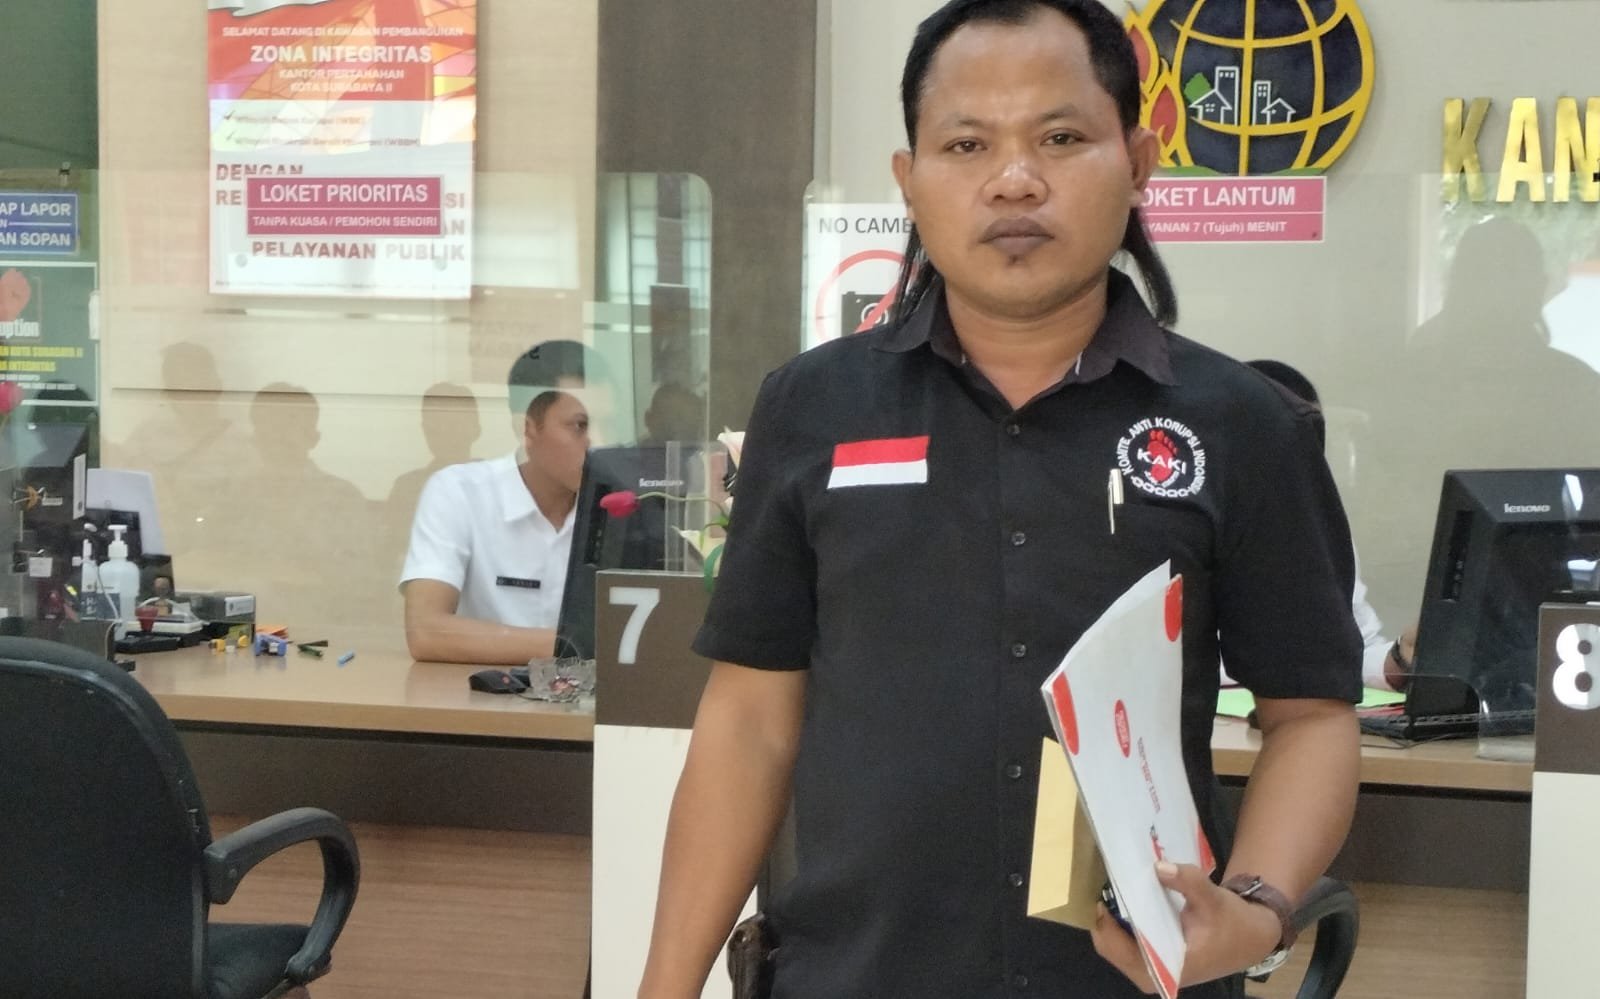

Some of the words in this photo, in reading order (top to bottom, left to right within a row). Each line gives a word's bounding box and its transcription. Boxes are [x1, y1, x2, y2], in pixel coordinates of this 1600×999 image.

[250, 44, 307, 62] ZONA
[312, 44, 432, 63] INTEGRITAS
[279, 68, 325, 79] KANTOR
[290, 81, 321, 92] KOTA
[260, 184, 323, 203] LOKET
[327, 183, 428, 203] PRIORITAS
[1142, 187, 1198, 207] OKET
[1203, 185, 1296, 206] LANTUM
[21, 202, 71, 217] LAPOR
[252, 216, 288, 227] TANPA
[289, 216, 328, 227] KUASA
[335, 216, 391, 227] PEMOHON
[393, 216, 438, 228] SENDIRI
[818, 216, 849, 234] NO
[855, 216, 914, 234] CAME
[1147, 221, 1191, 233] YANAN
[1193, 221, 1199, 232] 7
[1203, 221, 1244, 235] (Tujuh)
[1247, 221, 1287, 233] MENIT
[20, 232, 71, 247] SOPAN
[252, 241, 377, 259] PELAYANAN
[385, 243, 465, 261] PUBLIK
[1116, 436, 1134, 476] KOMITE
[1128, 418, 1153, 439] ANTI
[1154, 416, 1201, 449] KORUPSI
[1136, 448, 1187, 475] KAKI
[1503, 502, 1551, 514] lenovo
[608, 586, 660, 665] 7
[1552, 622, 1600, 711] 8
